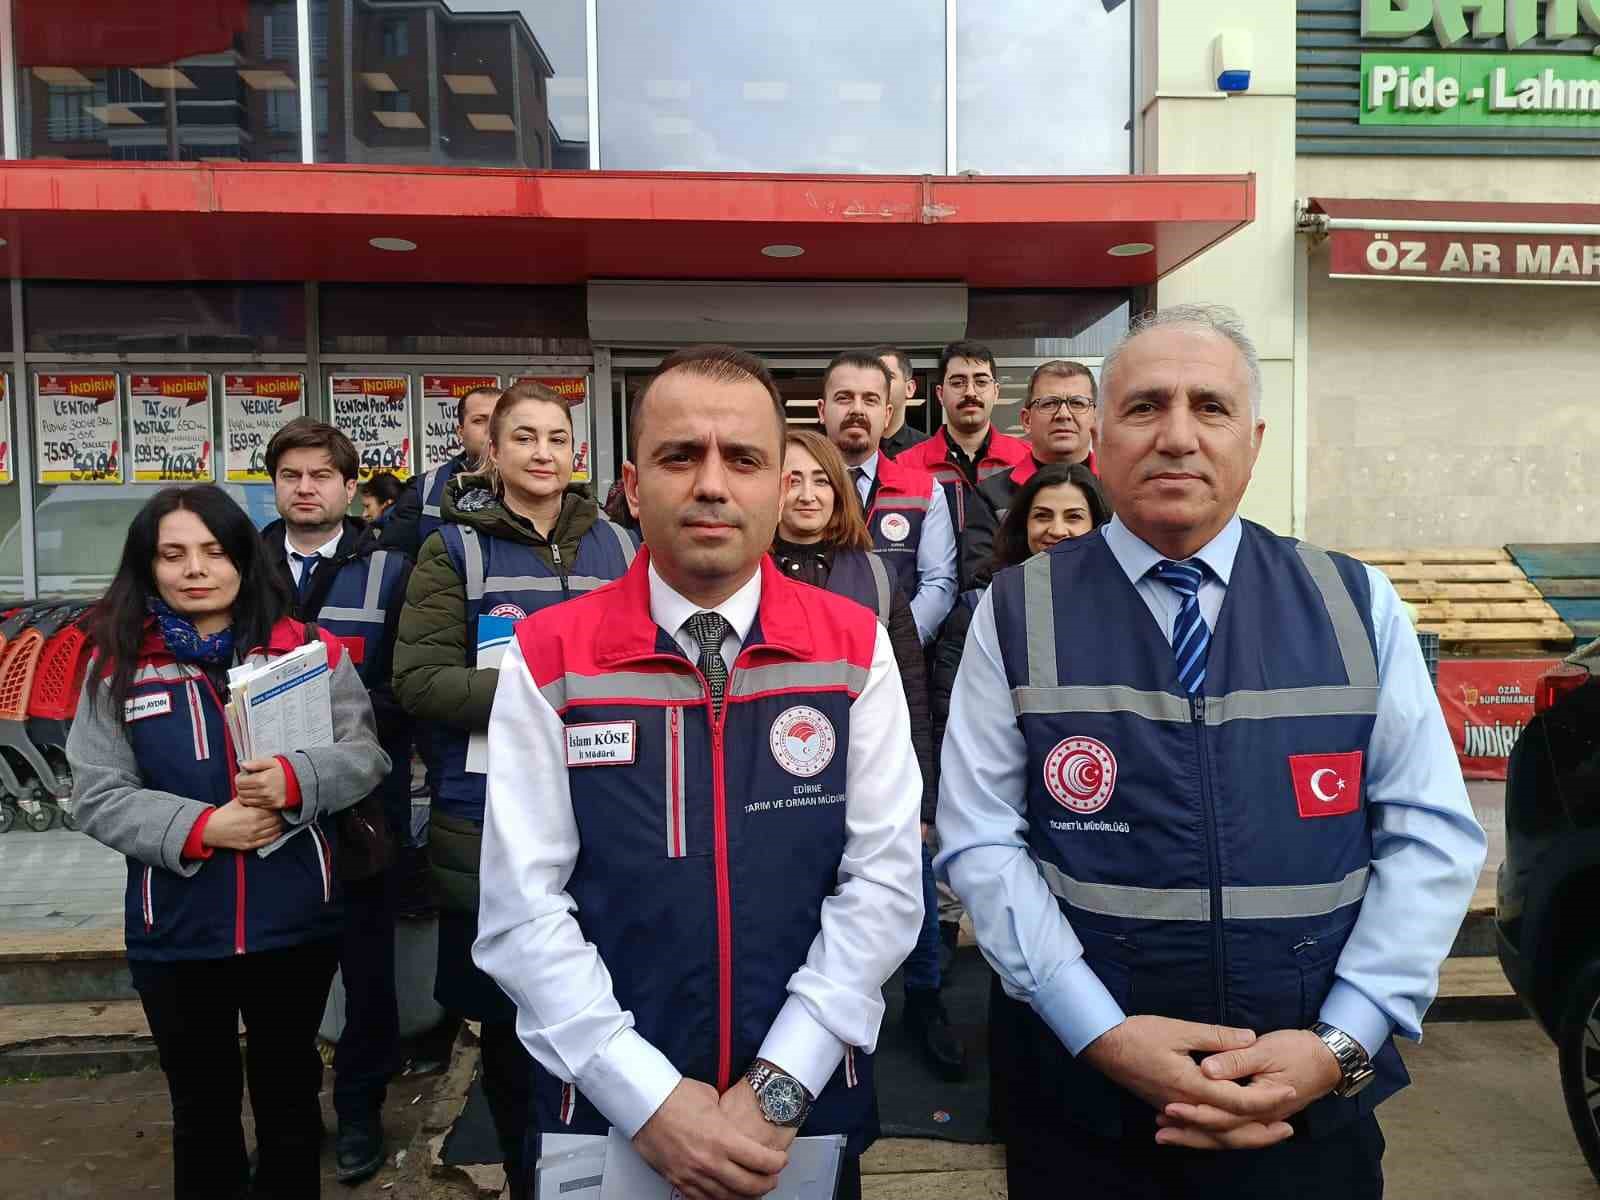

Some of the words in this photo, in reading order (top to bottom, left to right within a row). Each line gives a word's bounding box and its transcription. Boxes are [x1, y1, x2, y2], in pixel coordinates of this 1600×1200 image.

[1369, 66, 1459, 108] Pide
[1492, 67, 1600, 110] Lahm
[1366, 233, 1427, 271] ÖZ
[1440, 243, 1501, 273] AR
[142, 400, 161, 417] TAT
[241, 399, 282, 415] VERNEL
[569, 733, 592, 748] İslam
[594, 730, 630, 745] KÖSE
[585, 749, 616, 759] Müdürü
[793, 783, 823, 795] EDİRNE
[744, 801, 771, 814] TARIM
[772, 799, 784, 809] VE
[785, 796, 817, 808] ORMAN
[1049, 819, 1075, 831] TİCARET
[1083, 820, 1130, 833] MÜDÜRLÜĞÜ
